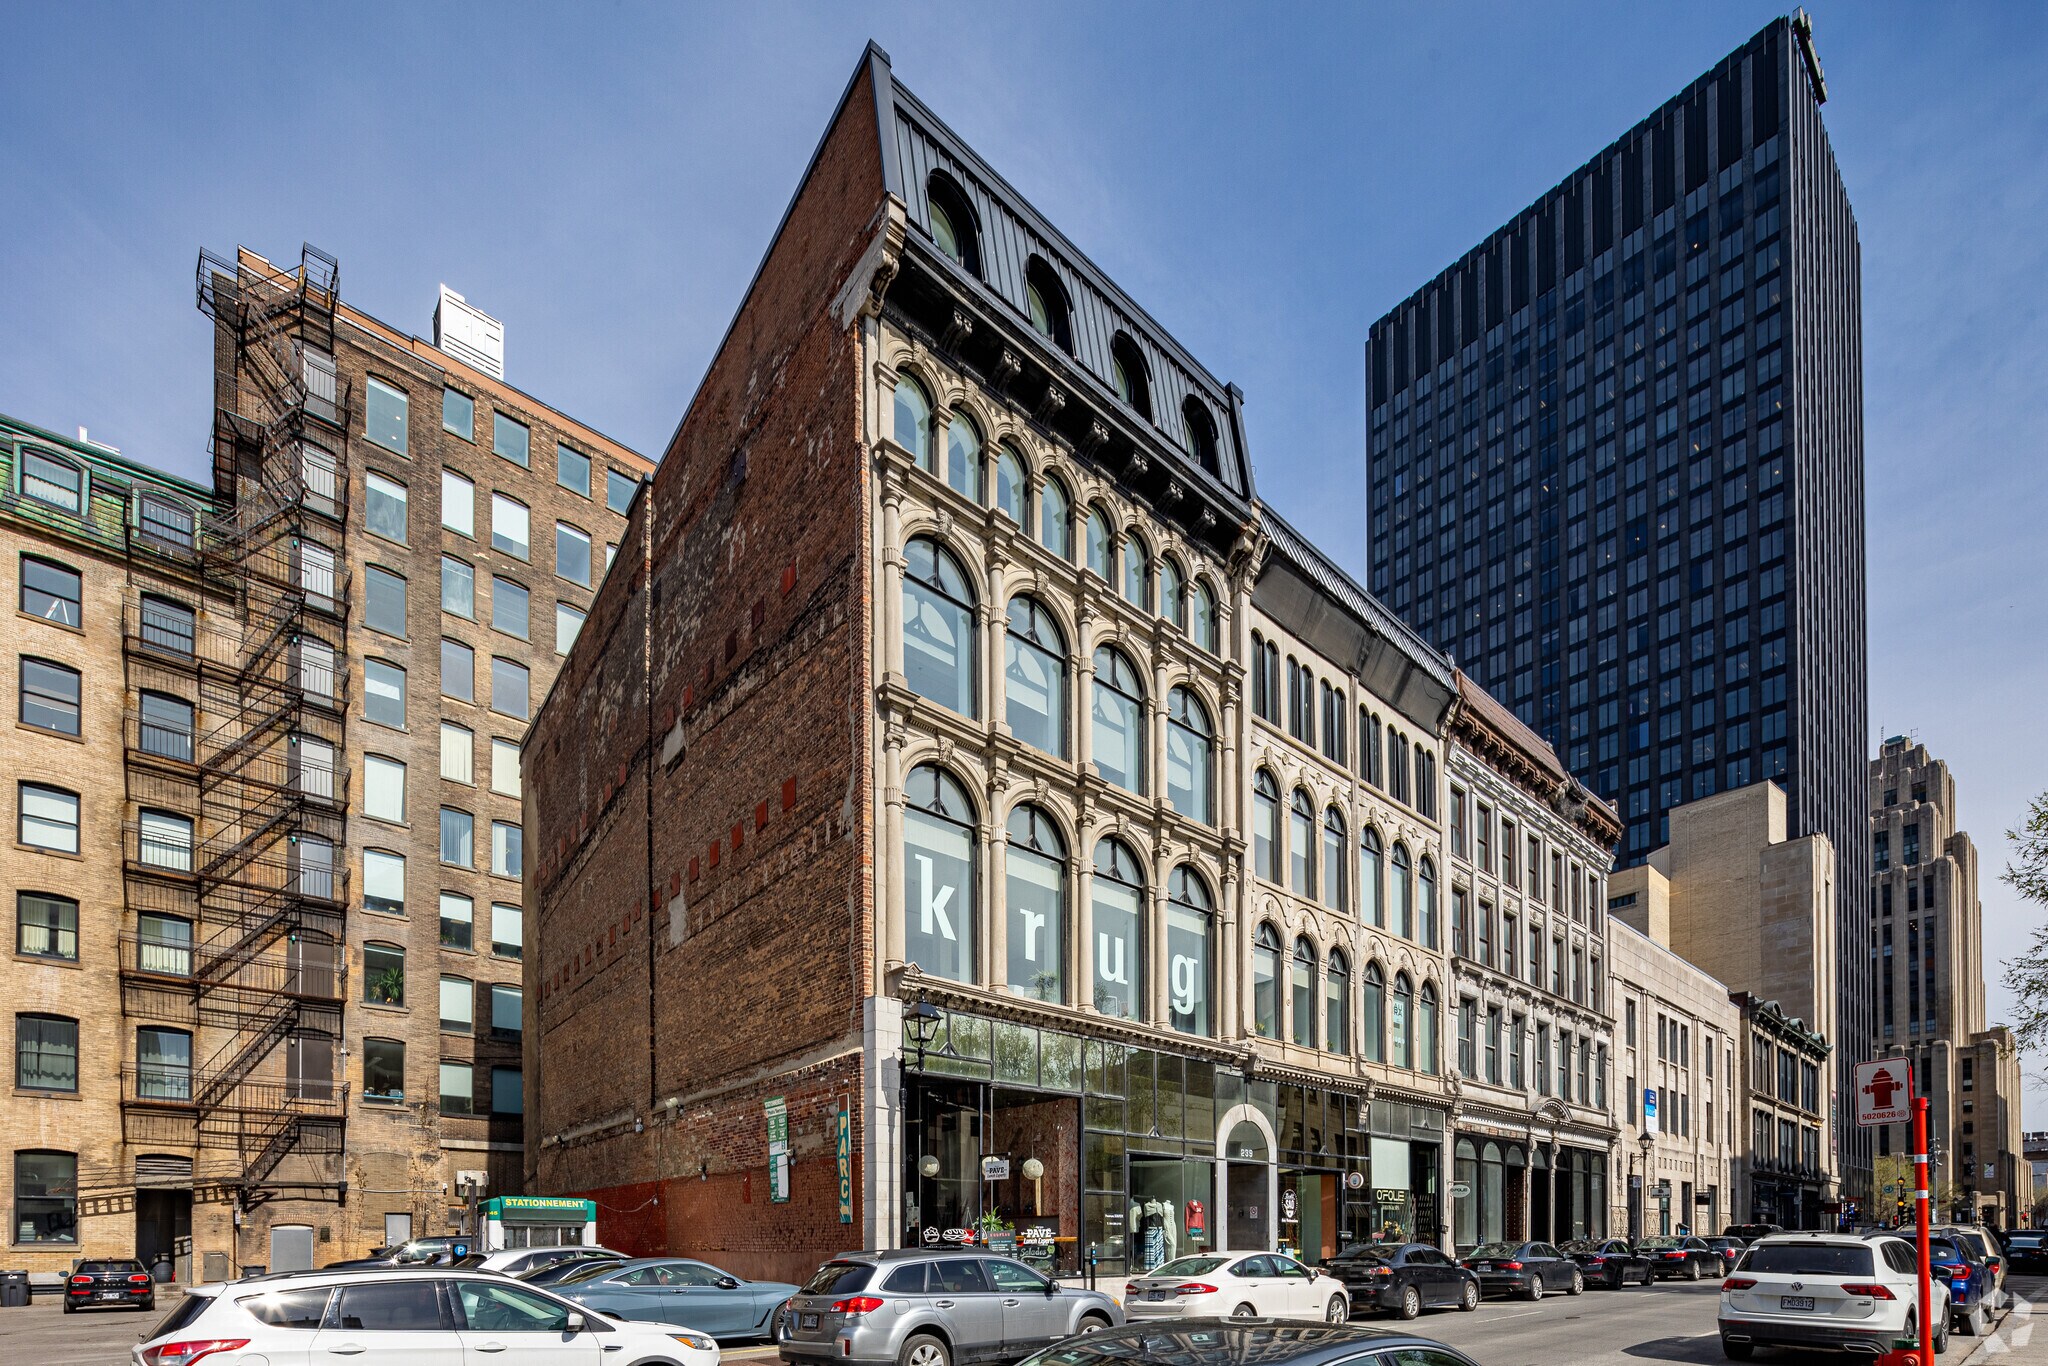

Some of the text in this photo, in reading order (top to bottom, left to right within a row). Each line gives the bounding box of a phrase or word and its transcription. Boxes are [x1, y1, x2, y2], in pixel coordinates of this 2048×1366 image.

[915, 853, 1199, 1015] krug
[1862, 1111, 1896, 1120] 5020626
[840, 1116, 849, 1198] PARC
[1241, 1148, 1254, 1158] 239
[505, 1198, 584, 1208] STATIONNEMENT
